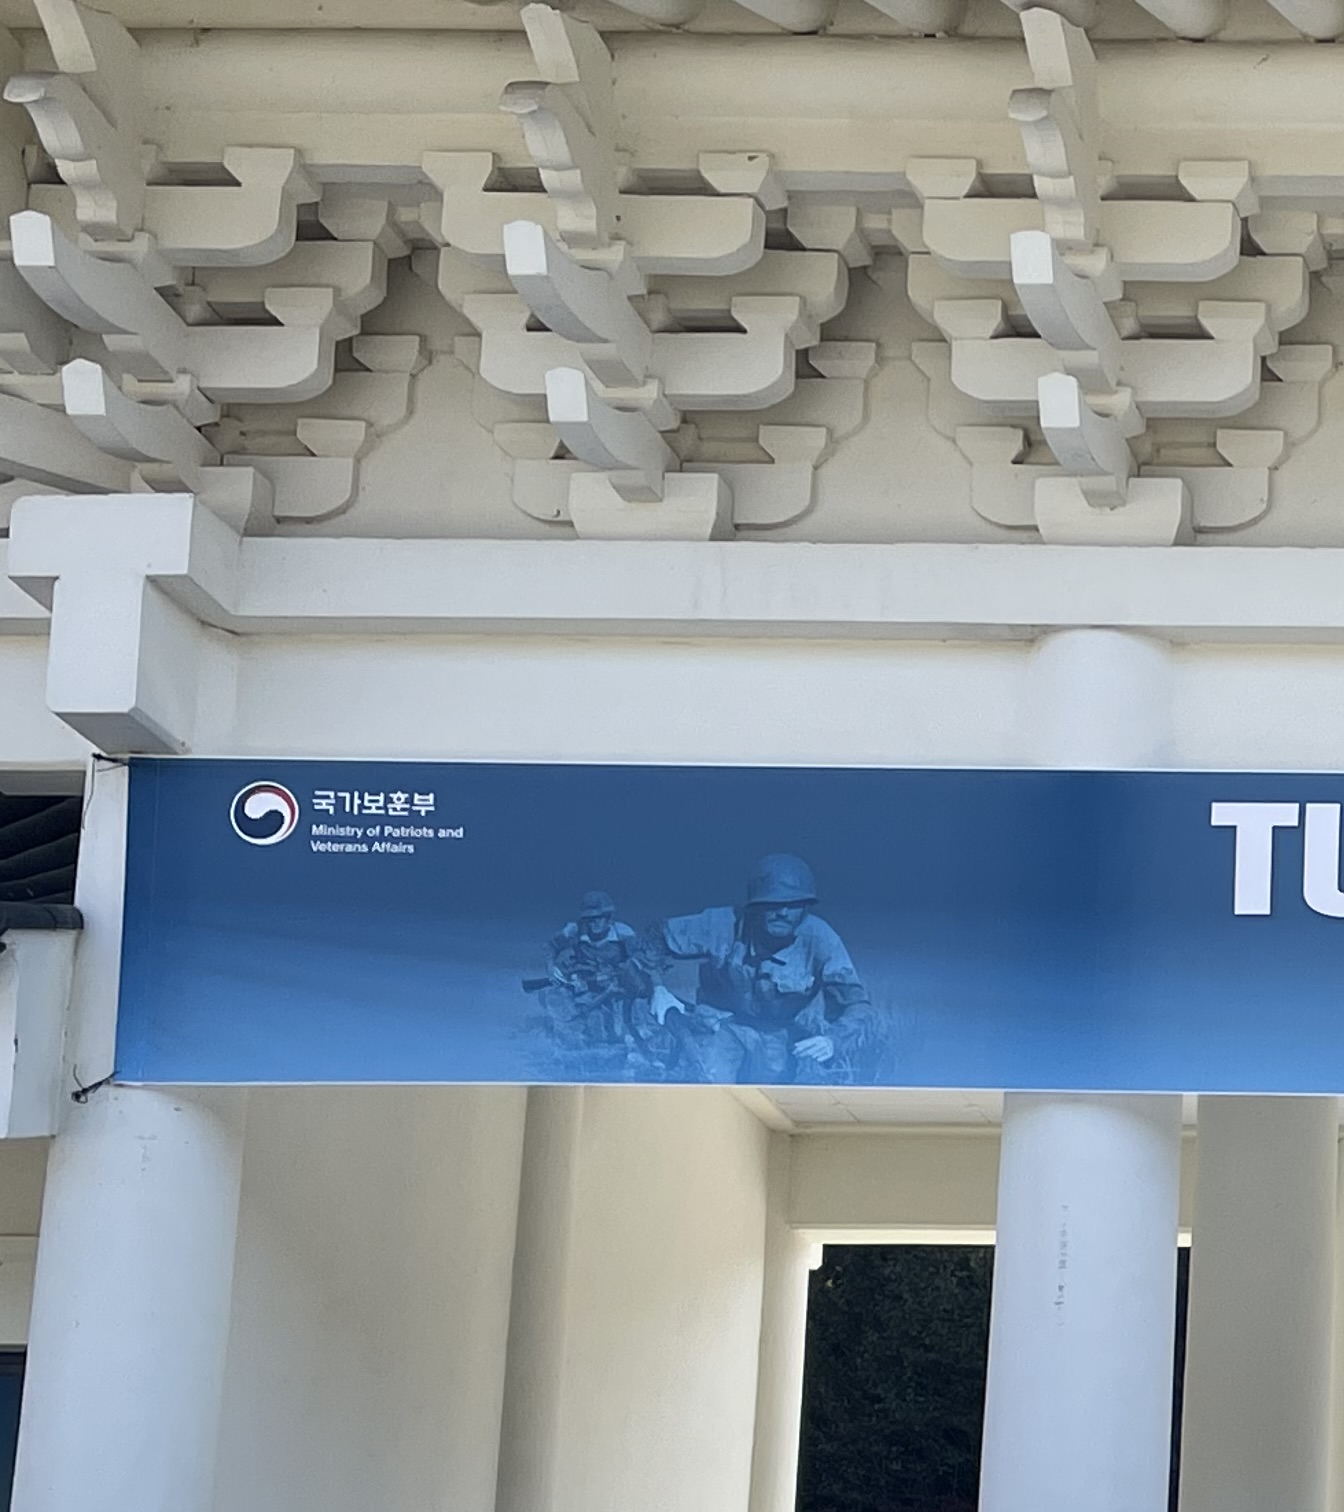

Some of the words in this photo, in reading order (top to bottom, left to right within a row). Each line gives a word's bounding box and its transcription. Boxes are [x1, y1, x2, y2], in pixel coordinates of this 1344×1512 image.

[311, 790, 436, 817] 국가보훈부
[311, 824, 364, 839] Ministry
[366, 825, 380, 838] of
[384, 825, 434, 838] Patriots
[437, 827, 464, 839] and
[310, 840, 369, 853] Veterans
[371, 841, 415, 854] Affairs
